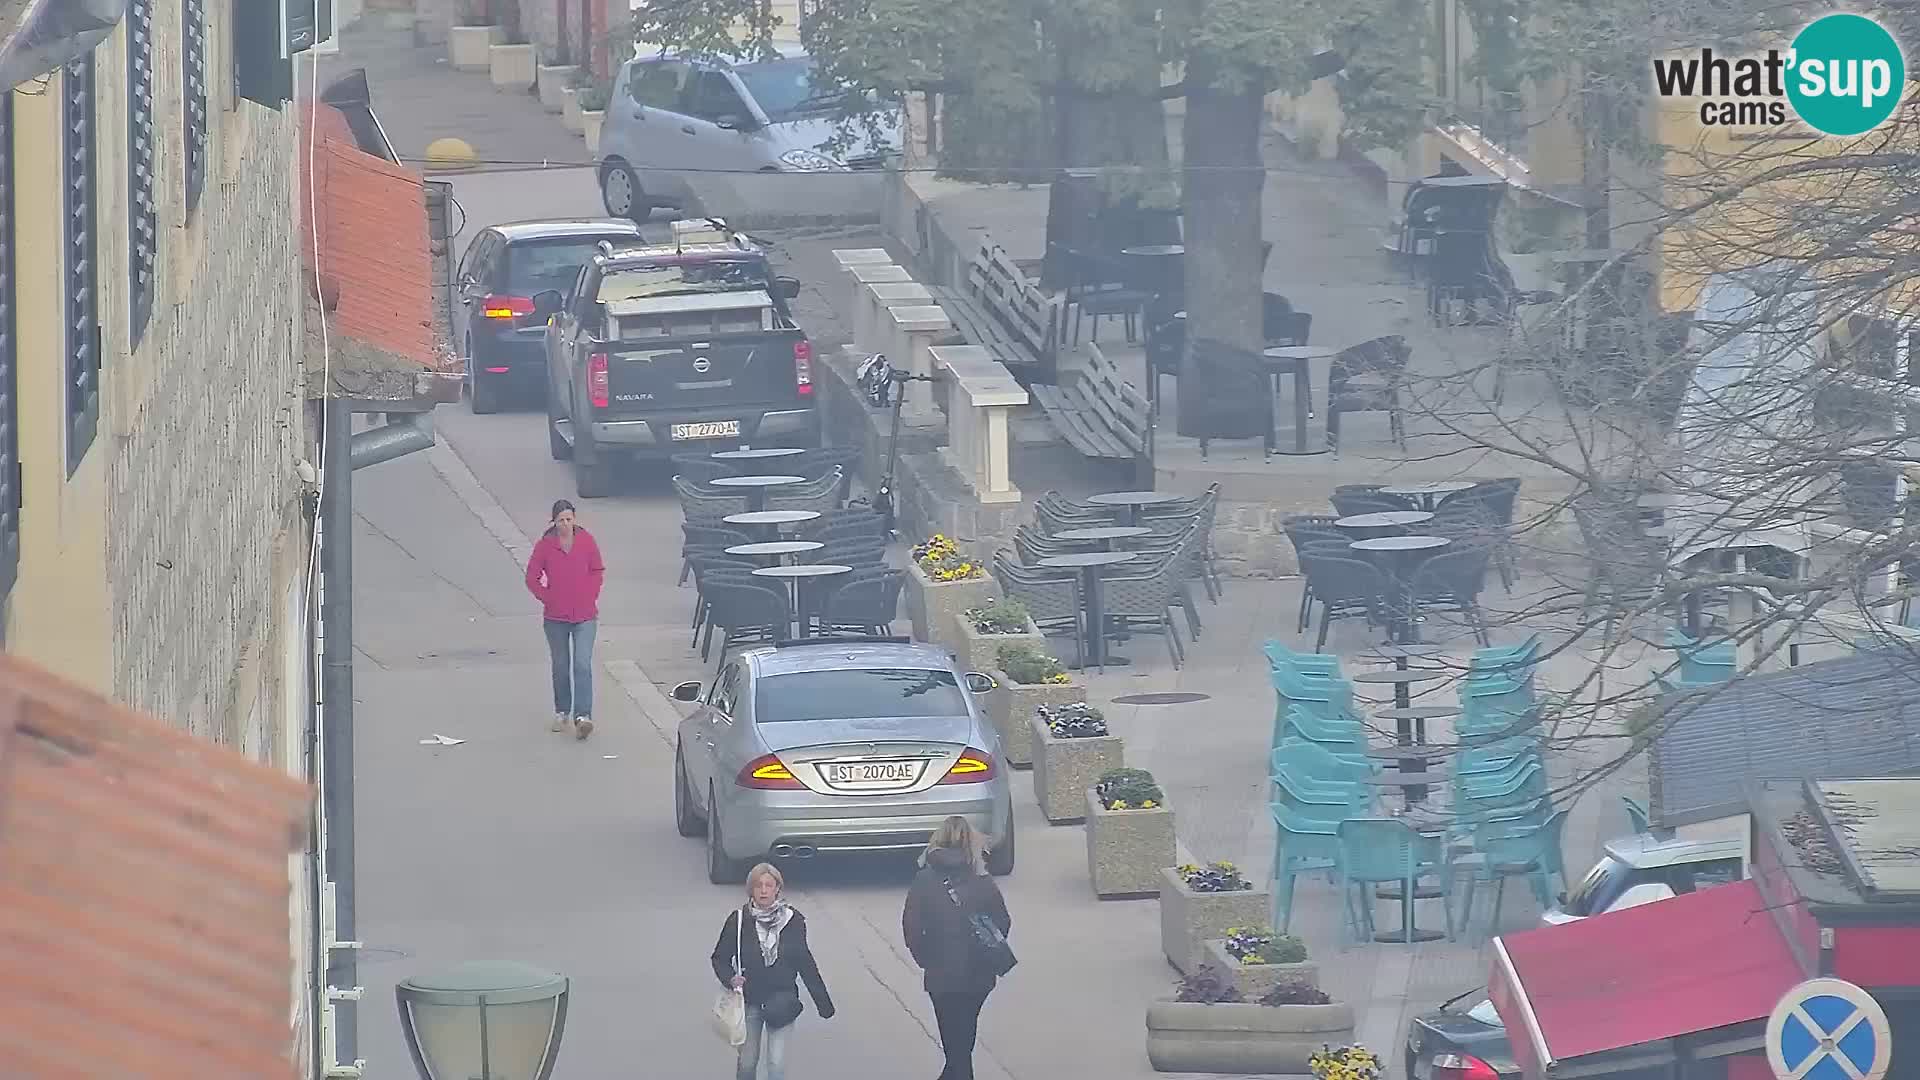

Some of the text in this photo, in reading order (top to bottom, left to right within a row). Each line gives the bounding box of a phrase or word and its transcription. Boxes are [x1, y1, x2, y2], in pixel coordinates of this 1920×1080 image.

[615, 393, 654, 401] NAVARA
[679, 425, 691, 437] ST
[839, 765, 854, 780] ST
